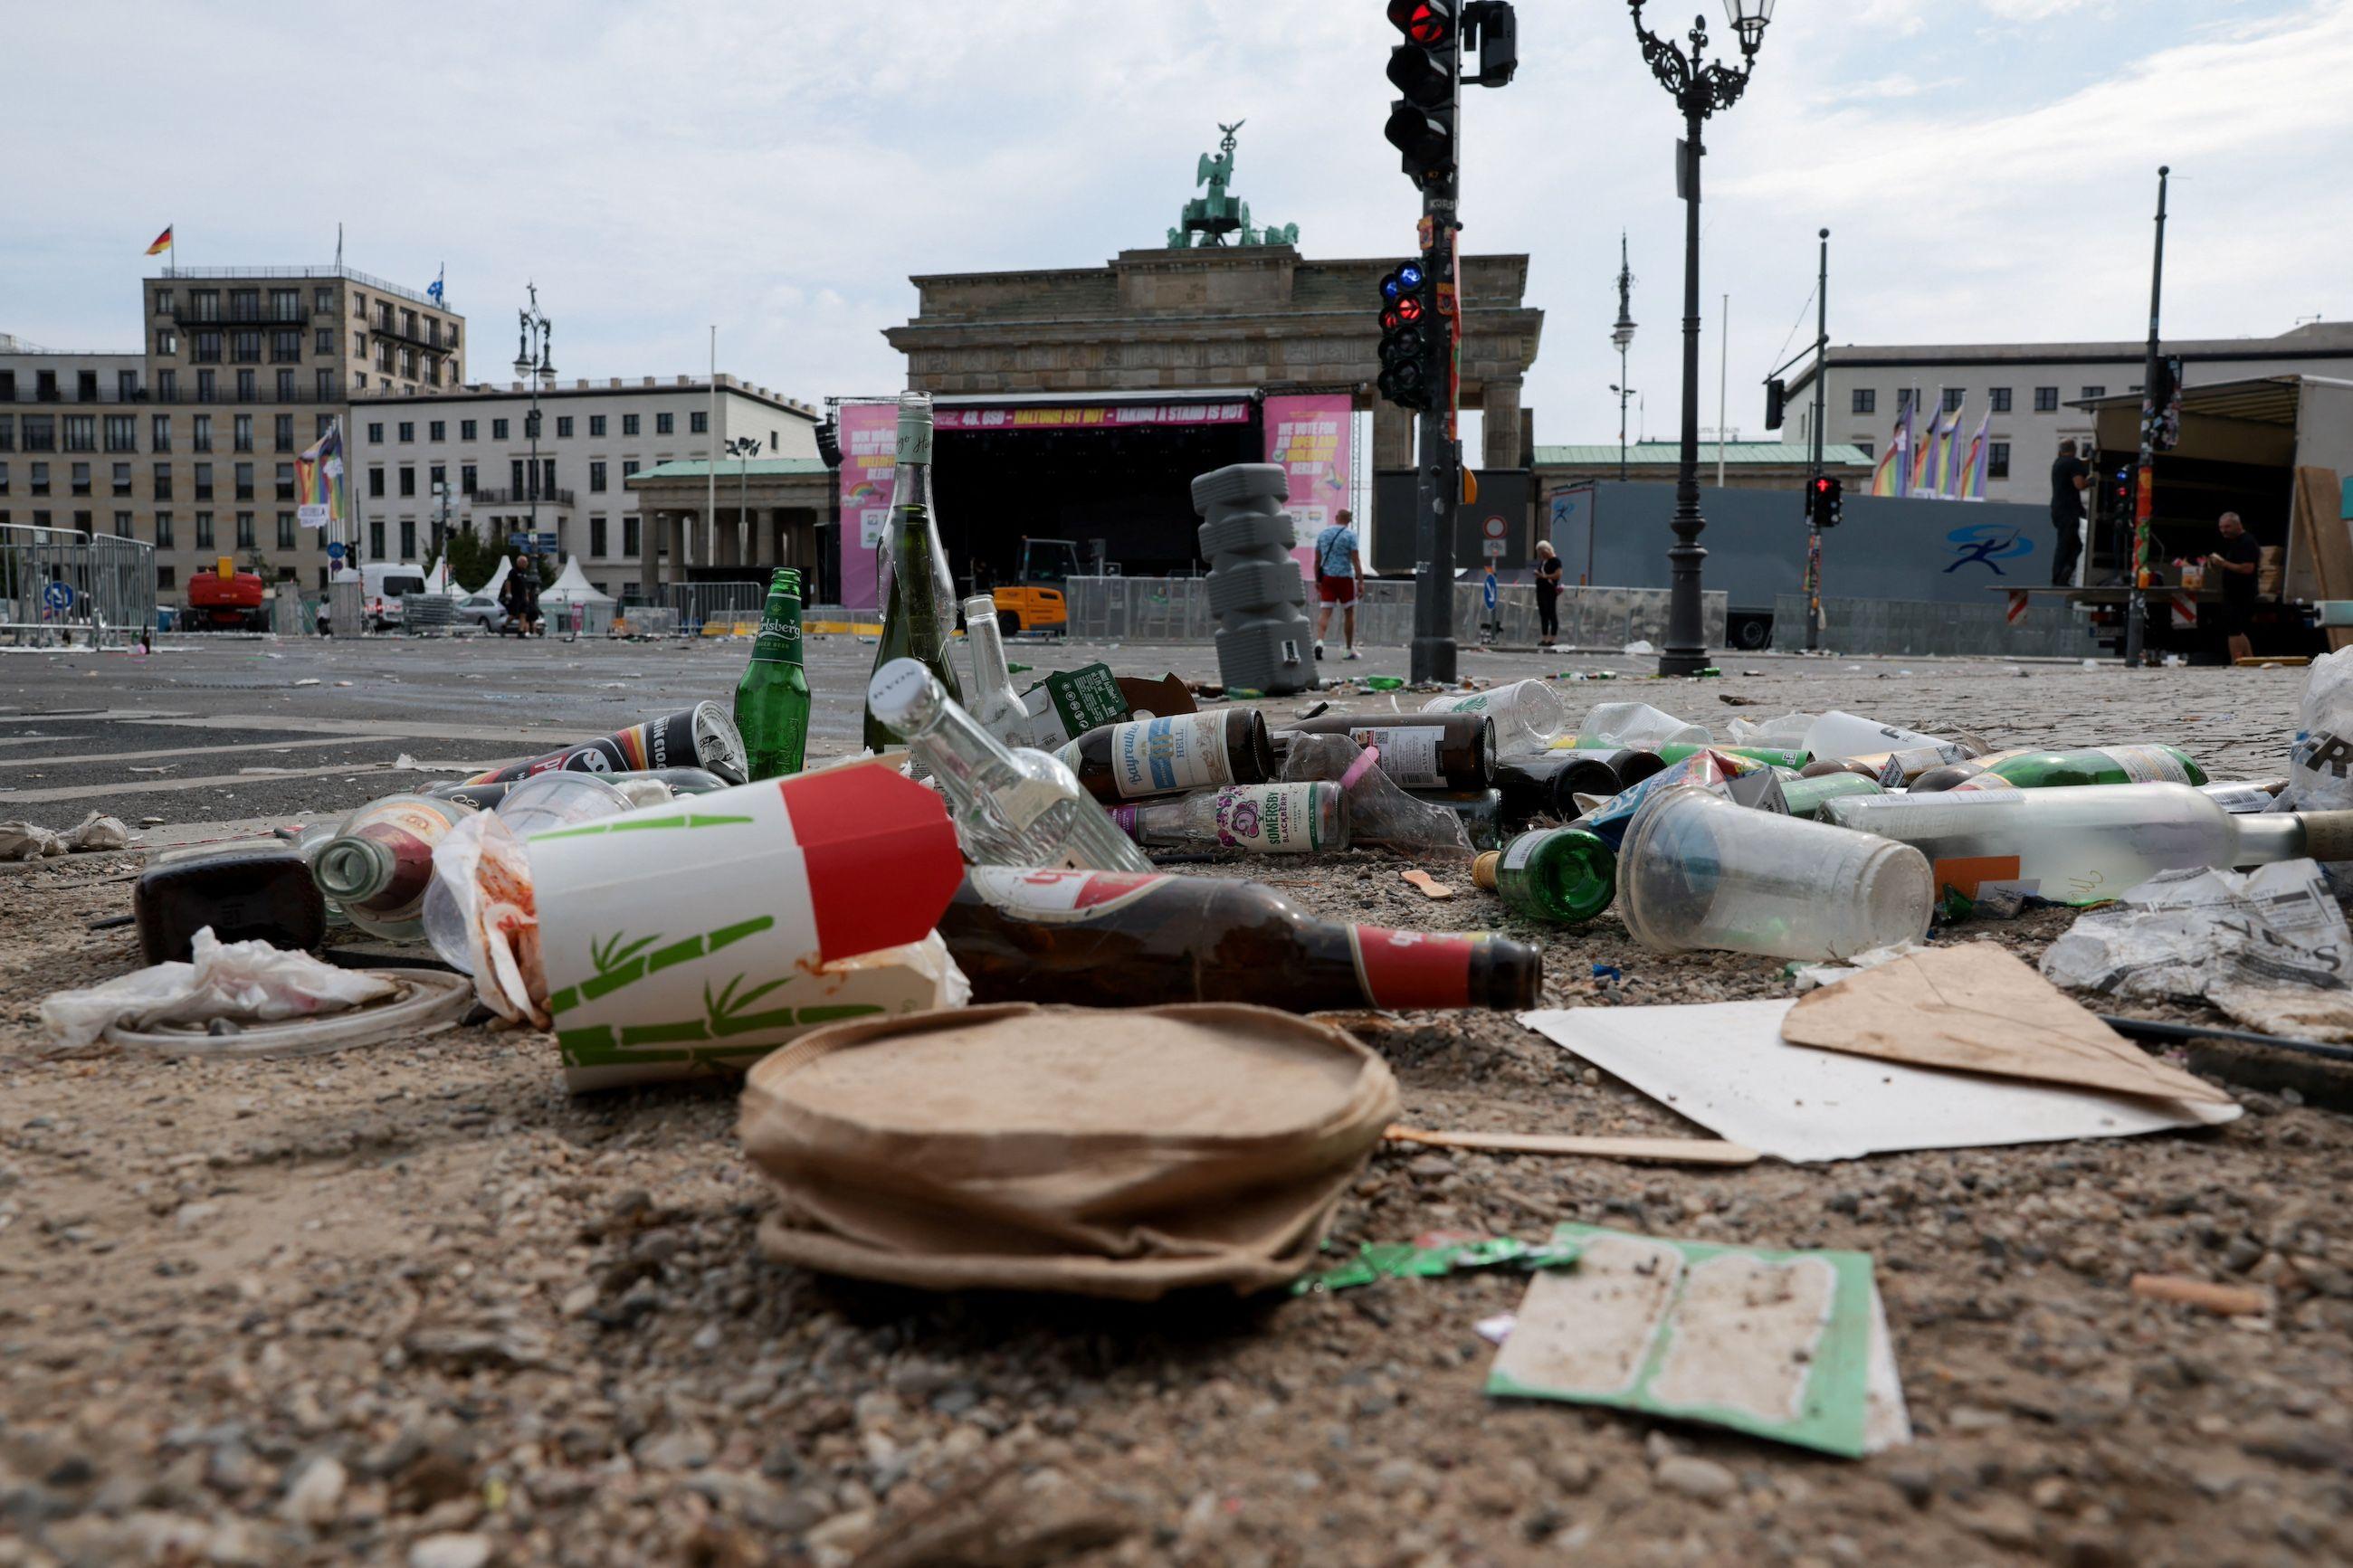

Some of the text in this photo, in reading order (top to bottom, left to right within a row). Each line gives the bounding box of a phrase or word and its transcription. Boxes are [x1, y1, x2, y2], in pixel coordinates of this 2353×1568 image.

[982, 410, 1005, 425] CSD
[1014, 409, 1062, 424] HALTUNG
[1063, 408, 1081, 424] IST
[1083, 407, 1105, 423] HOT
[1116, 407, 1157, 423] TAKING
[1157, 406, 1167, 422] A
[1167, 405, 1206, 422] STAND
[1206, 404, 1220, 420] IS
[1221, 404, 1245, 420] HOT
[1278, 421, 1338, 436] WE VOTE FOR
[1276, 434, 1338, 449] AN OPEN AND
[1286, 448, 1335, 461] INCLUSIVE
[1291, 462, 1324, 475] BERLIN
[1176, 728, 1185, 758] HELL
[1266, 792, 1281, 845] SOMERSBY
[1281, 792, 1290, 843] BLACKBERRY
